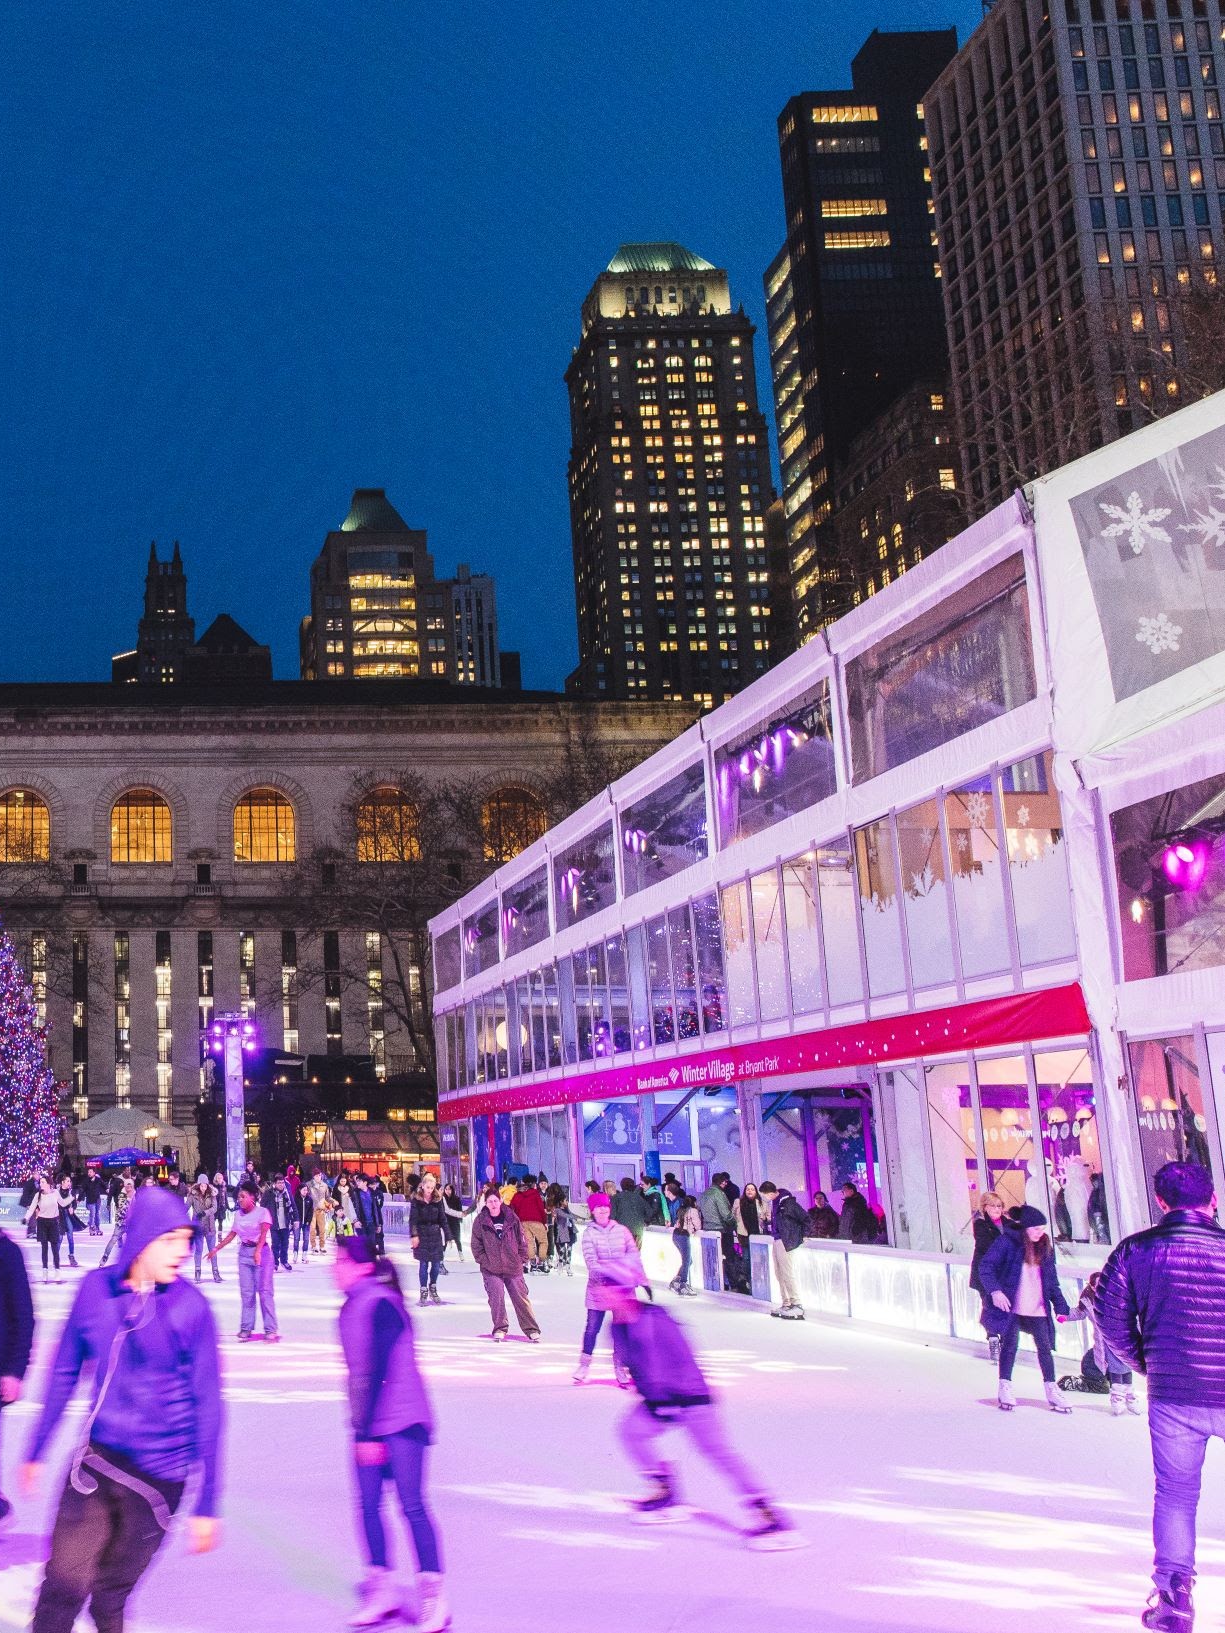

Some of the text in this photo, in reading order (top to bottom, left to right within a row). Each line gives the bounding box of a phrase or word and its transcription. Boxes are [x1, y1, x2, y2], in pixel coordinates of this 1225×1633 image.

[680, 1064, 708, 1083] Winter
[707, 1059, 735, 1081] Village
[738, 1063, 745, 1075] at
[745, 1060, 765, 1076] Bryant
[764, 1056, 779, 1071] Park
